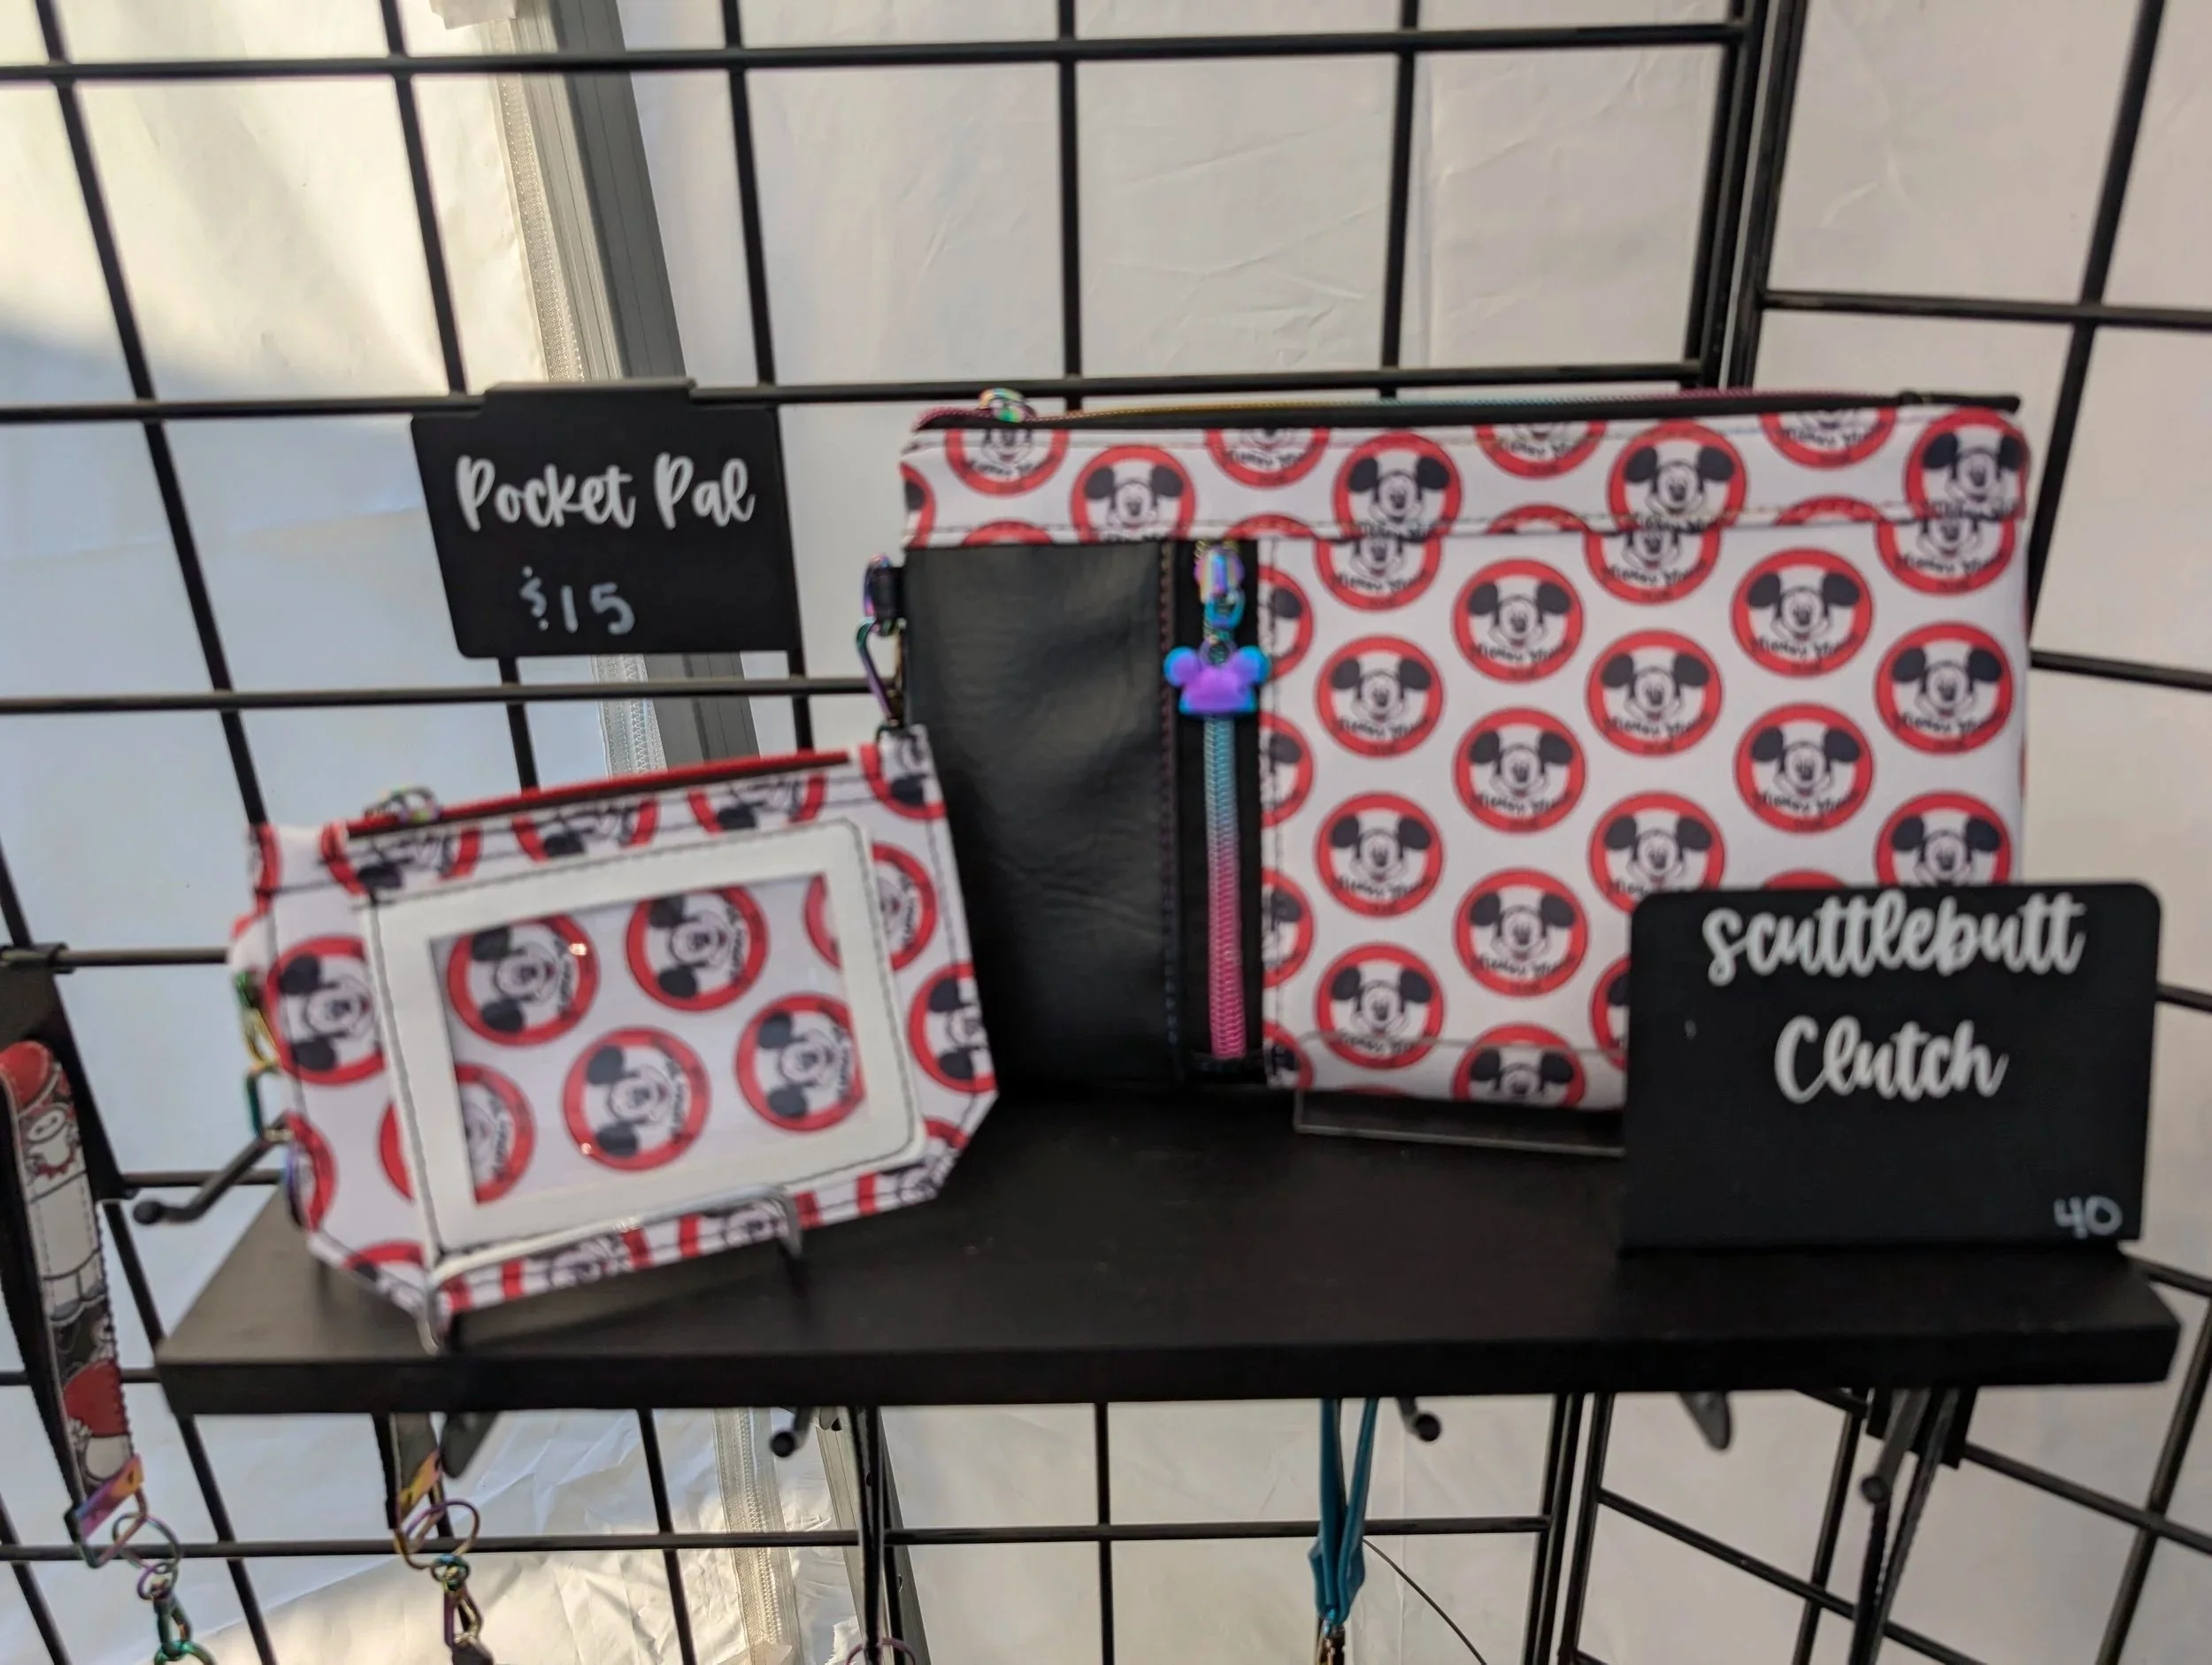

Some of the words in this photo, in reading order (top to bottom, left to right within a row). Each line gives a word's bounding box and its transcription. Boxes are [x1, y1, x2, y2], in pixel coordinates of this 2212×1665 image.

[456, 455, 636, 532] Pocket
[654, 452, 756, 529] Pal
[520, 566, 635, 634] $15
[1774, 1016, 2008, 1103] Clutch
[2054, 1196, 2123, 1237] 40
